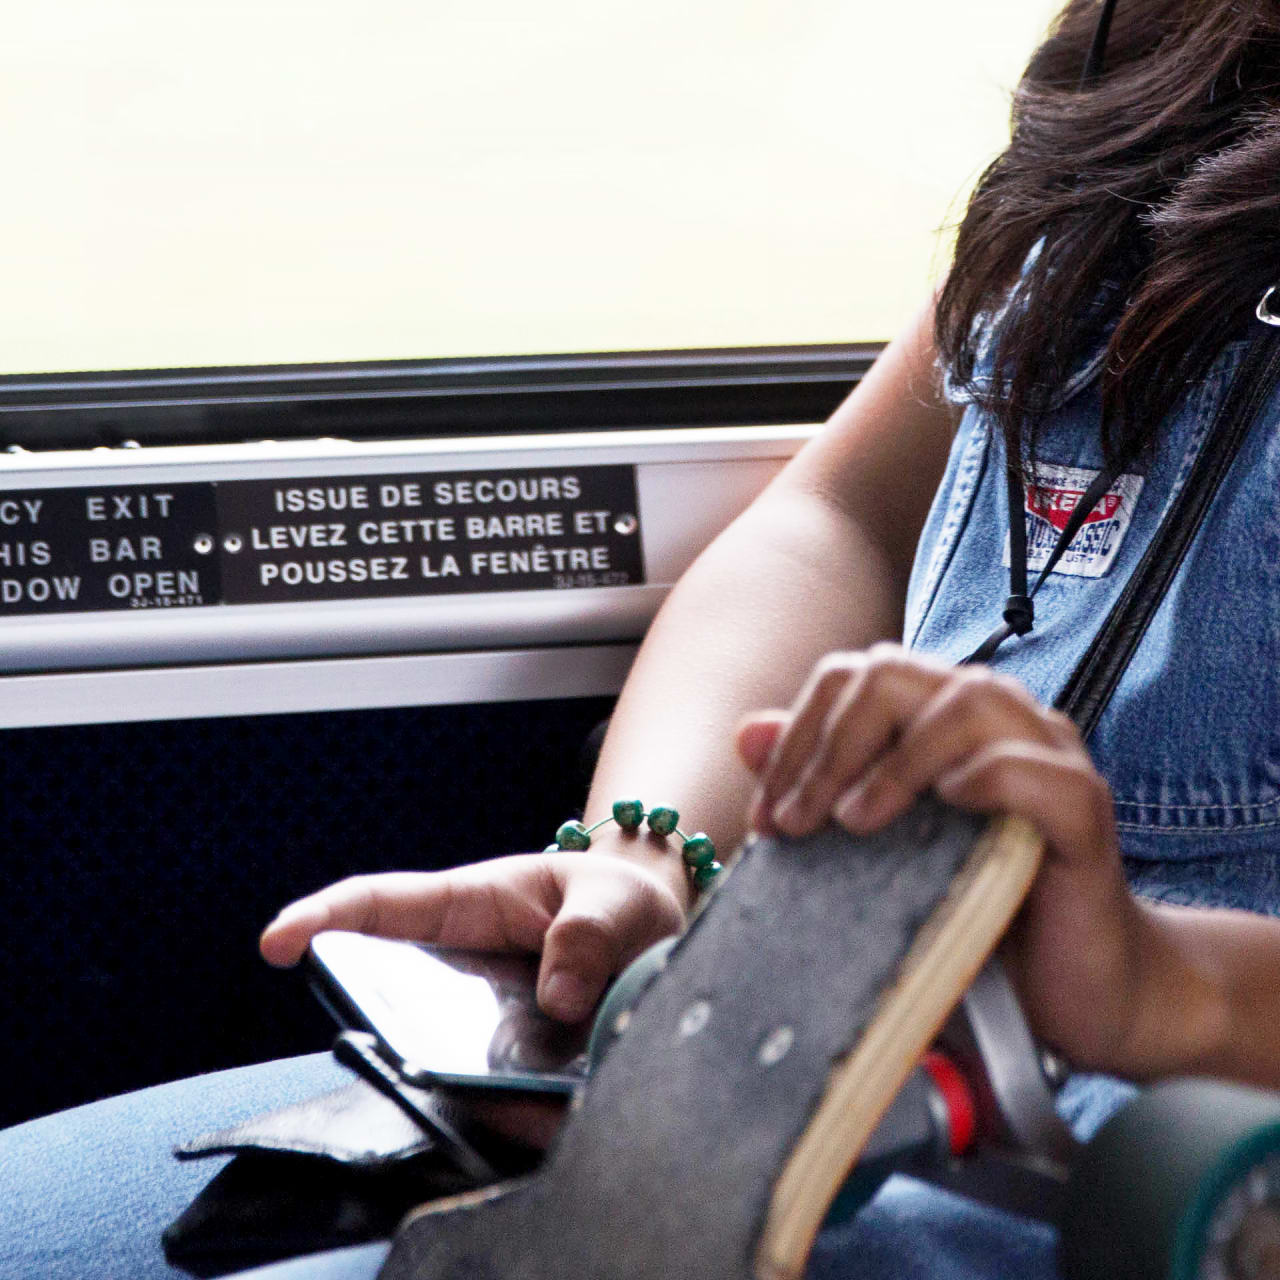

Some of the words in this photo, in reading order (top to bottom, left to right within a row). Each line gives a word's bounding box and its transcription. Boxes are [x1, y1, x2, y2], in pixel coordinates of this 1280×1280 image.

[86, 492, 175, 522] EXIT
[275, 485, 370, 513] ISSUE
[379, 483, 423, 507] DE
[433, 476, 581, 504] SECOURS
[251, 523, 349, 551] LEVEZ
[358, 517, 457, 545] CETTE
[465, 512, 565, 540] BARRE
[574, 510, 611, 534] ET
[89, 536, 163, 563] BAR
[259, 557, 410, 587] POUSSEZ
[420, 554, 462, 578] LA
[470, 544, 611, 576] FENÊTRE
[107, 570, 201, 598] OPEN
